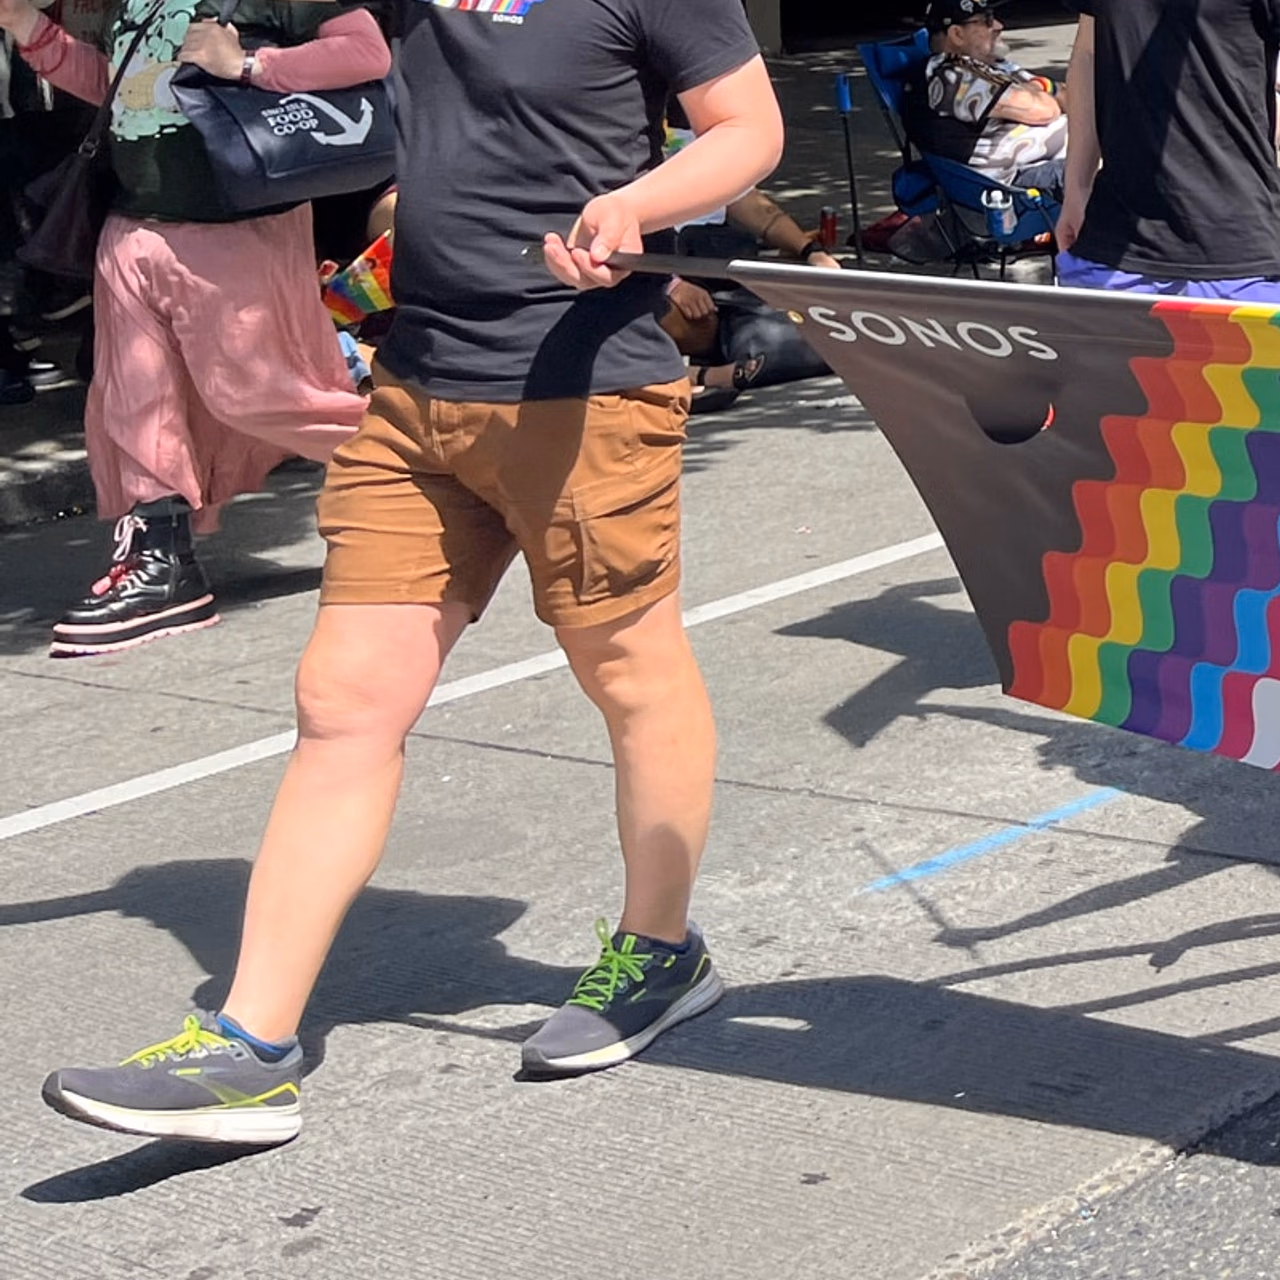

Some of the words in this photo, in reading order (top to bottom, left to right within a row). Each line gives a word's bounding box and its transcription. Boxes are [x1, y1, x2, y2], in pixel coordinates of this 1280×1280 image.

[267, 109, 314, 127] FOOD
[274, 118, 319, 136] CO-OP
[808, 306, 1058, 360] SONOS
